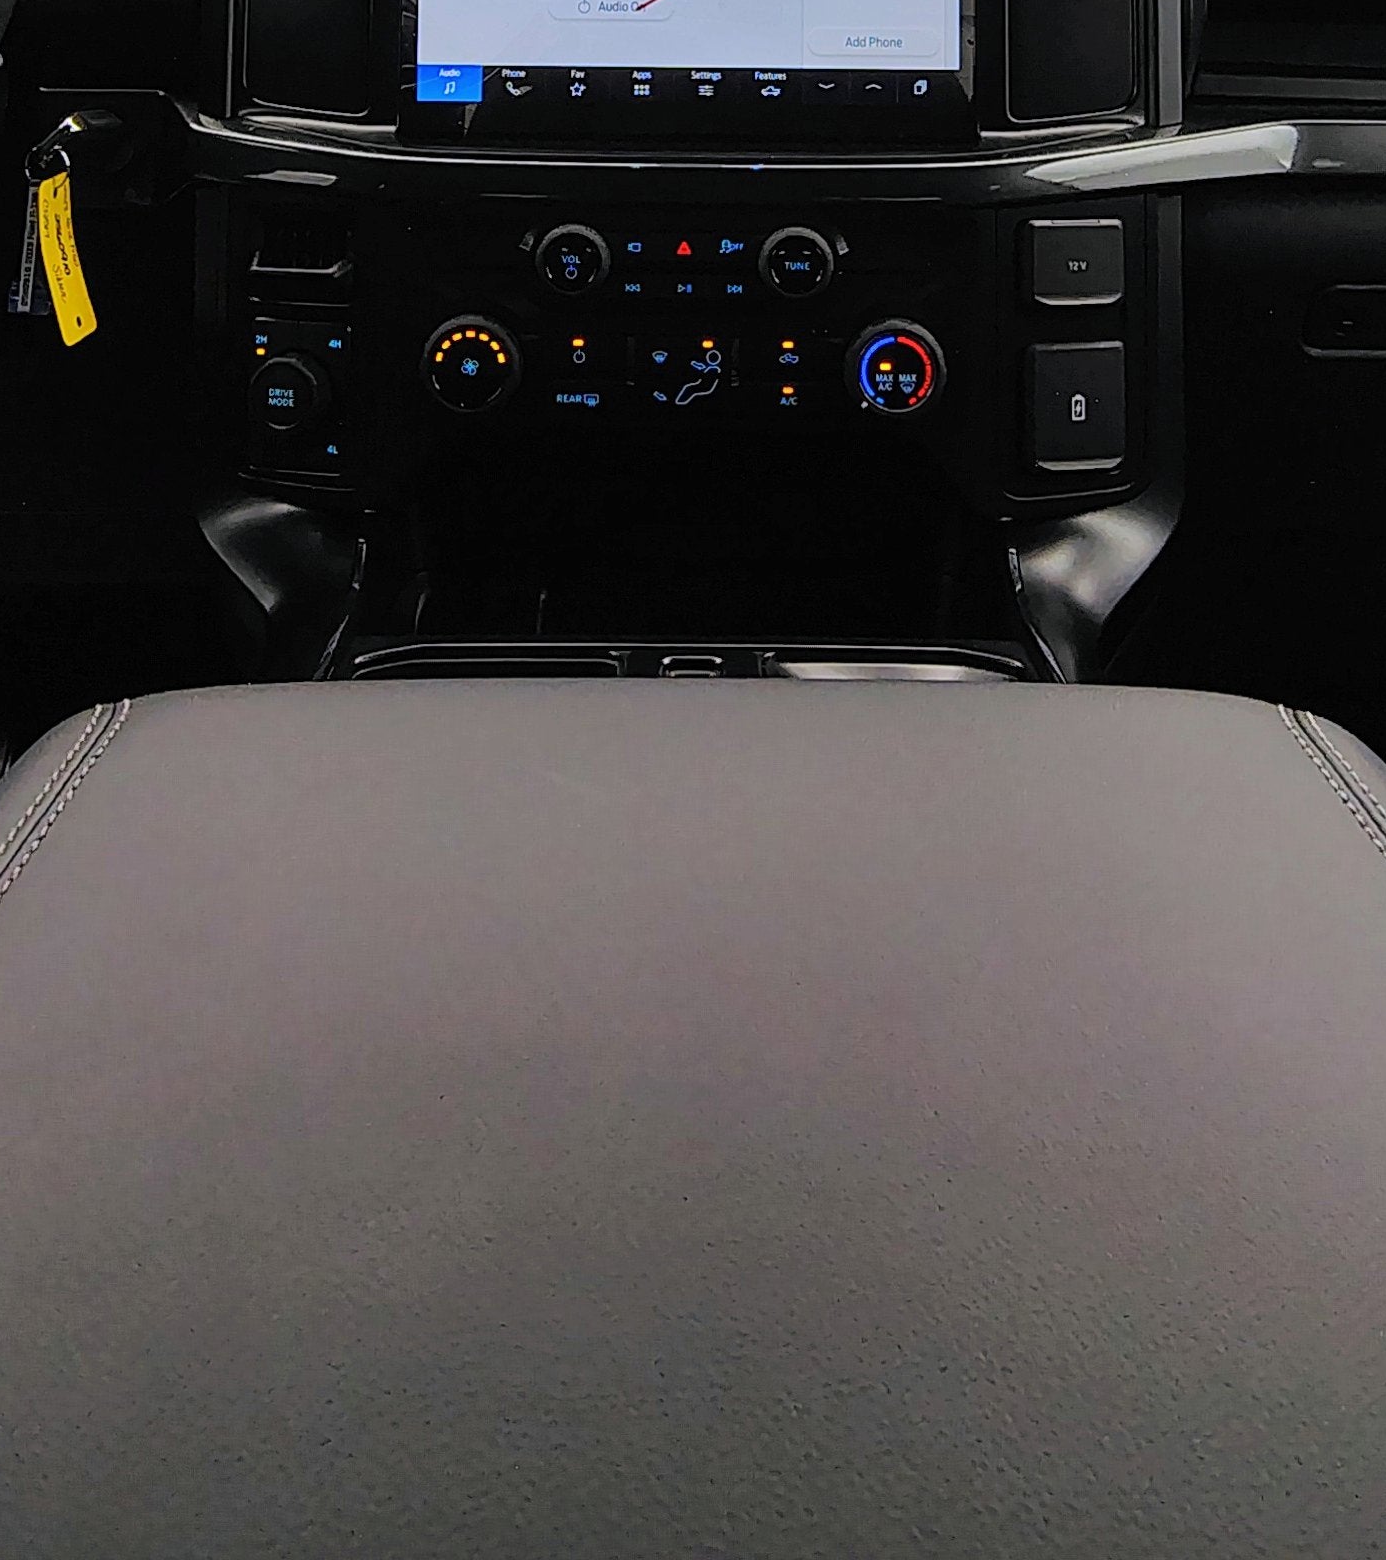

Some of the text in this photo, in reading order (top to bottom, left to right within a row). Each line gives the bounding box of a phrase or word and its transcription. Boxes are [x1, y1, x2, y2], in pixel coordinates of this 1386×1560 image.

[598, 1, 629, 13] Audio
[845, 36, 903, 49] Add Phone
[439, 68, 461, 78] Audio
[501, 69, 527, 79] Phone
[570, 69, 586, 79] Fav
[632, 70, 652, 81] Apps
[691, 70, 722, 82] Settings
[754, 71, 787, 81] Features
[561, 255, 581, 264] VOL
[784, 261, 811, 271] TUNE
[255, 334, 268, 344] 2H
[328, 339, 342, 349] 4H
[875, 373, 894, 383] MAX
[898, 373, 917, 383] MAX
[877, 382, 893, 392] A/C
[268, 387, 294, 398] DRIVE
[268, 398, 295, 408] MODE
[556, 394, 582, 403] REAR
[780, 397, 798, 406] A/C
[326, 445, 339, 455] 4L
